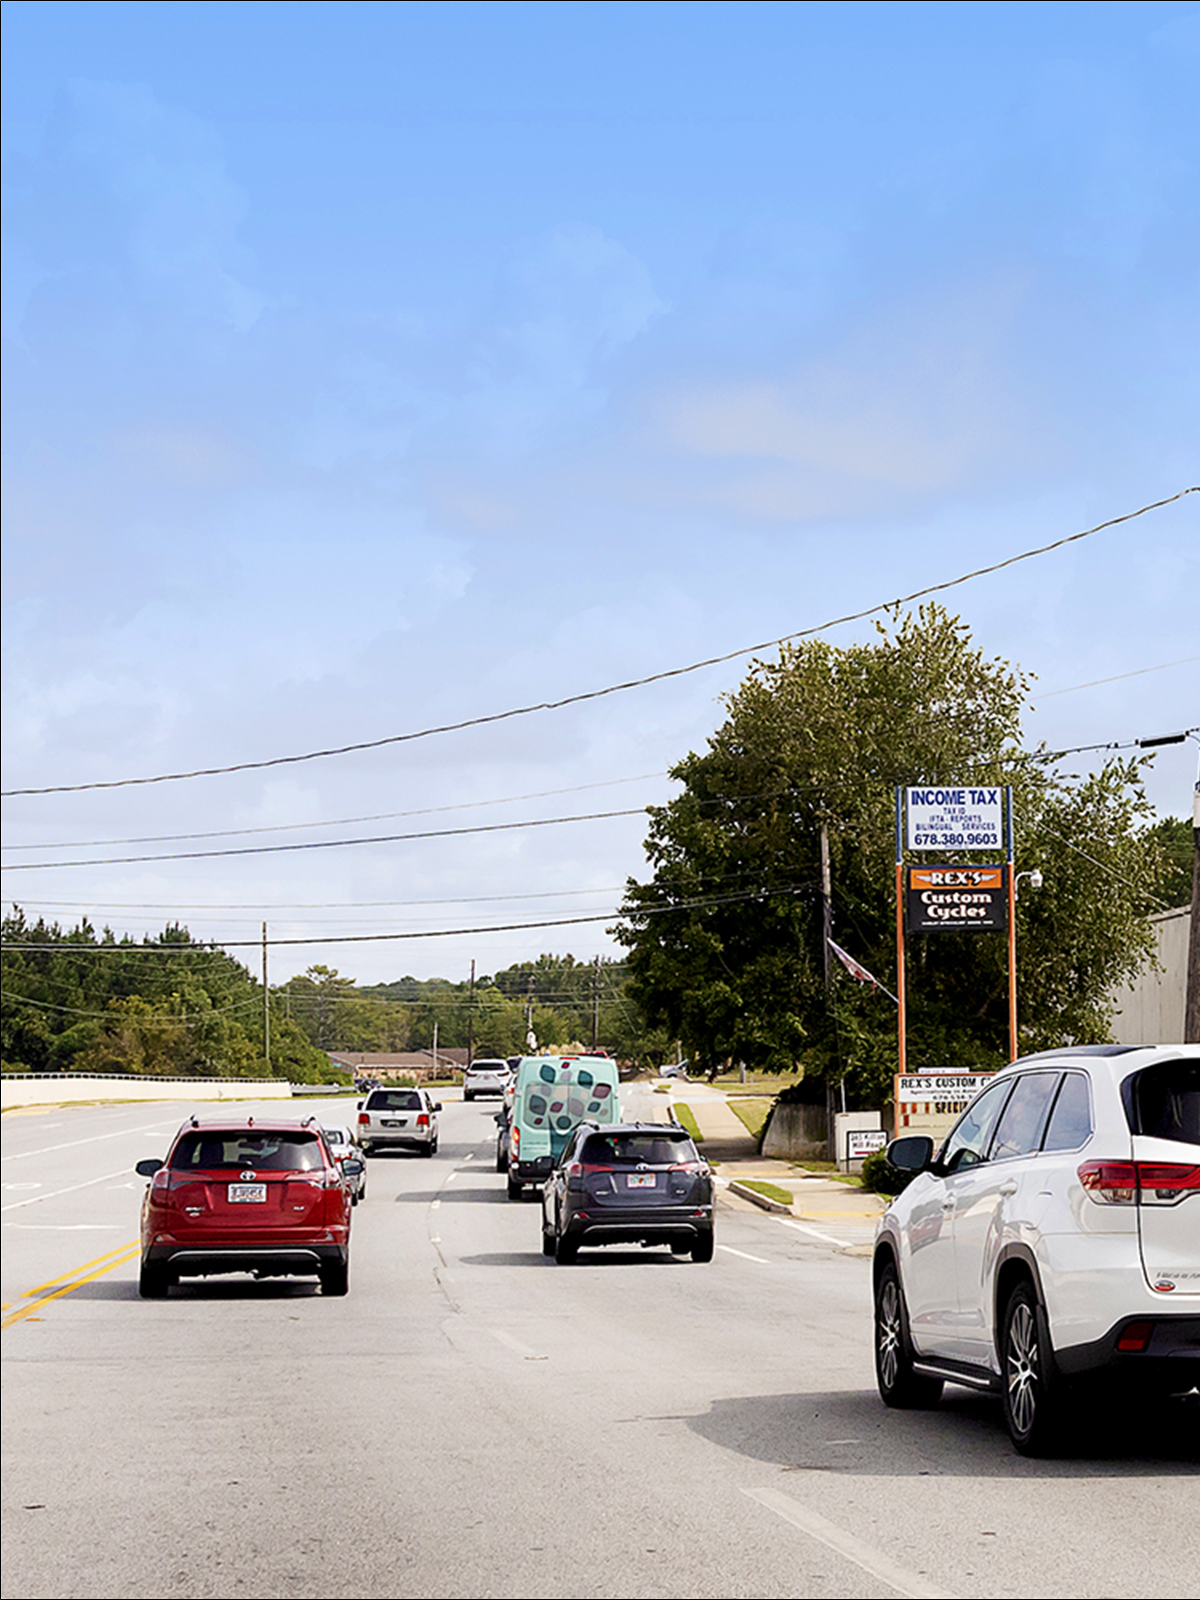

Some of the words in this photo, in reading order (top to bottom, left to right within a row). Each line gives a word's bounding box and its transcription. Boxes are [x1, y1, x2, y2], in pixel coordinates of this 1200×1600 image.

[911, 790, 965, 805] INCOME
[969, 790, 998, 805] TAX
[943, 807, 956, 815] TAX
[950, 815, 982, 823] REPORTS
[916, 823, 953, 831] BILINGUAL
[961, 823, 996, 831] SERVICES
[914, 833, 998, 845] 678.380.9603
[931, 871, 982, 886] REX'S
[921, 890, 992, 904] Custom
[927, 904, 987, 920] Cycles
[901, 1077, 932, 1089] REX'S
[935, 1077, 976, 1089] CUSTOM
